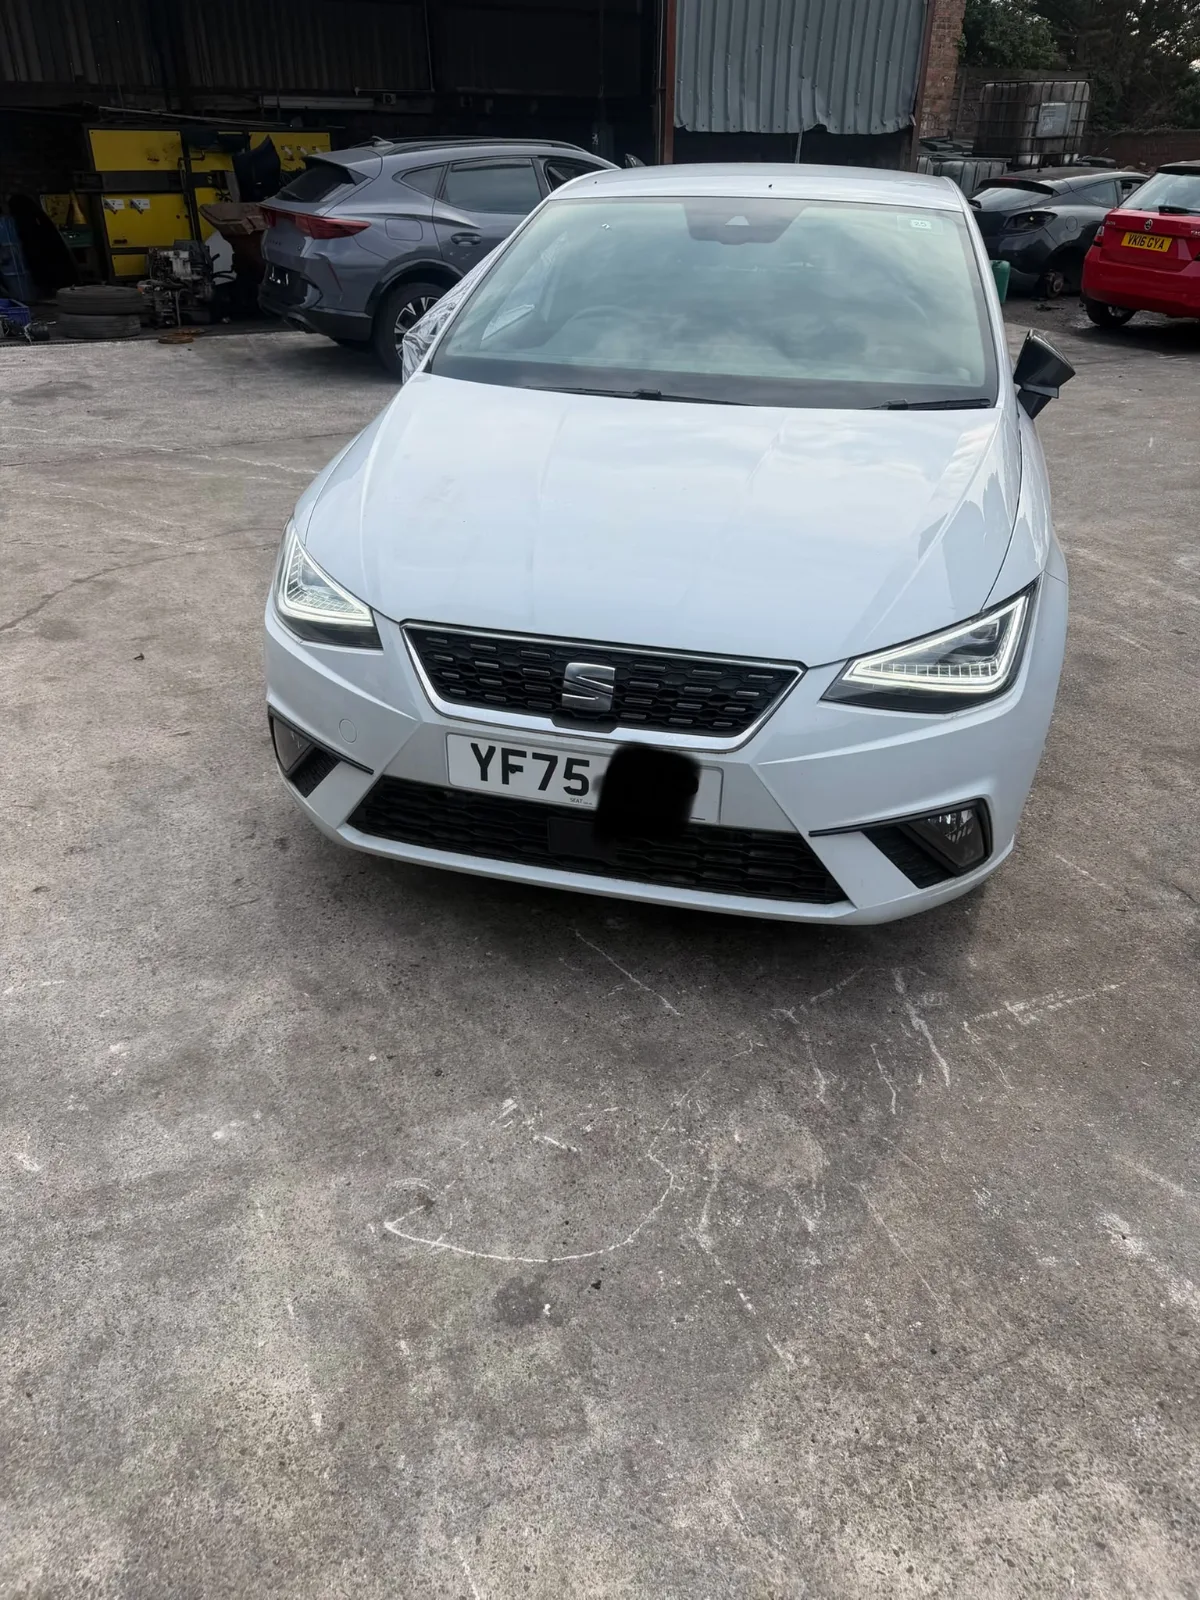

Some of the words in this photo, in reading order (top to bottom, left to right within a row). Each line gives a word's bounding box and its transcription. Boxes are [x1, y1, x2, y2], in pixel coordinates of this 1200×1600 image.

[1128, 234, 1147, 246] VK16
[1147, 237, 1165, 249] GYA
[470, 743, 590, 796] YF75
